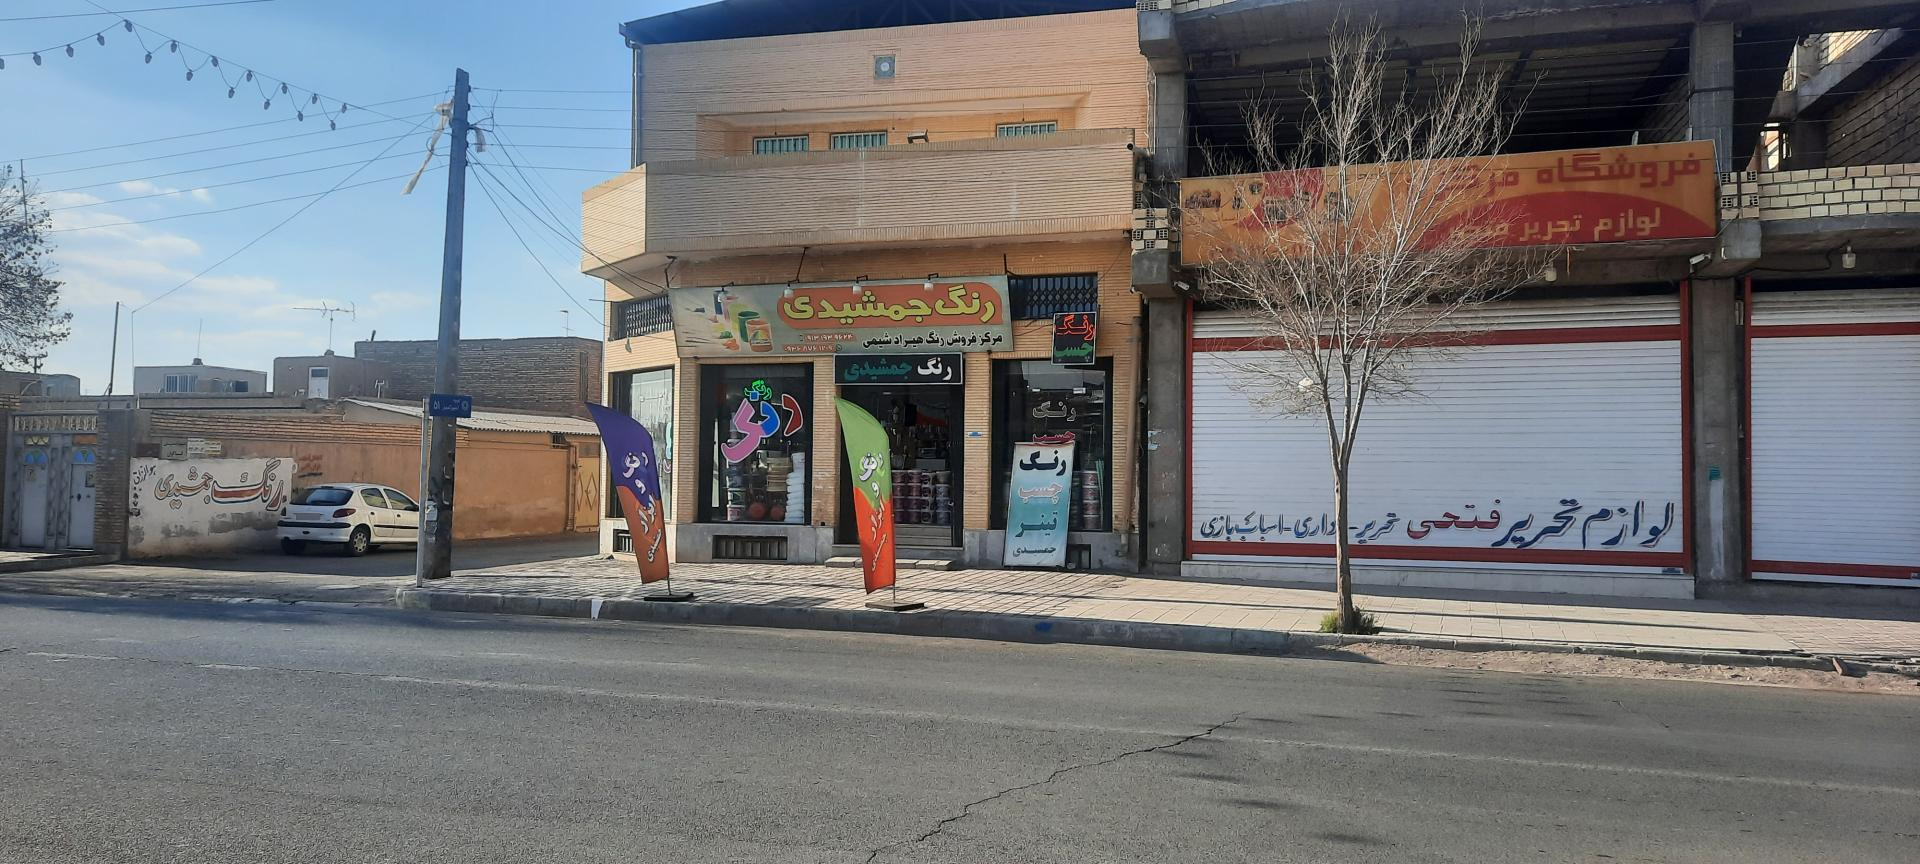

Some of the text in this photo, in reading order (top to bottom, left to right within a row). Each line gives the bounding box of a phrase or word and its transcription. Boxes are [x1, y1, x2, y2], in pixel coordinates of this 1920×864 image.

[1536, 152, 1700, 188] فروشگاه
[1519, 214, 1581, 242] تحریر
[1594, 208, 1661, 241] لوازم
[782, 284, 996, 325] رنگ جمشیدی
[862, 332, 892, 349] شیمی
[925, 330, 945, 347] رنگ
[946, 331, 977, 347] فروش
[979, 332, 1003, 346] مرکز
[1053, 314, 1096, 340] رنگ
[843, 357, 952, 381] رنگ جمشیدی
[154, 459, 284, 511] رنگ جمشیدی
[1018, 482, 1063, 505] چسب
[1015, 512, 1058, 538] تینر
[1407, 499, 1501, 540] فتحی
[1491, 498, 1583, 549] تحریر
[1580, 500, 1675, 549] لوازم
